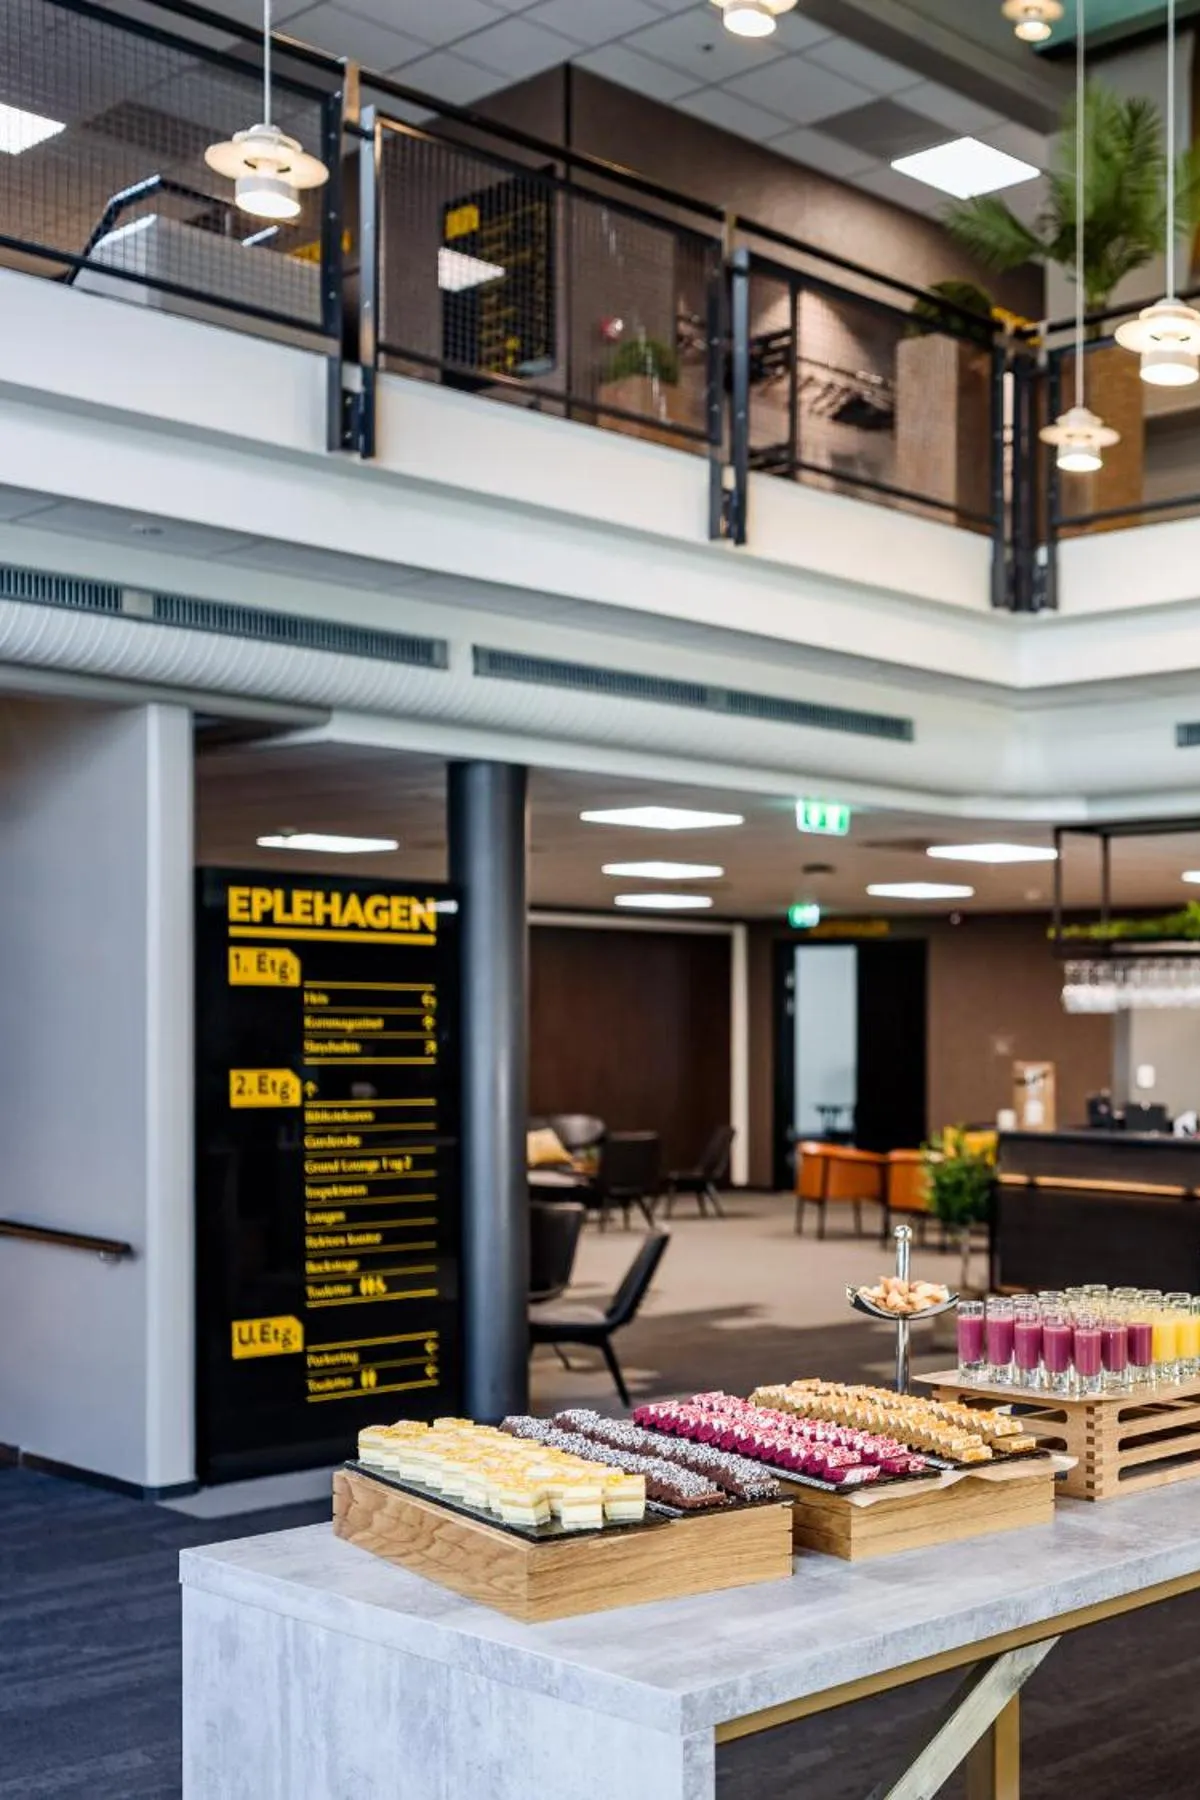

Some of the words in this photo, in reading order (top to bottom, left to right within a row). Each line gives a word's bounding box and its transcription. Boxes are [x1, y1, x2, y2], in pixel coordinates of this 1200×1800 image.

[228, 885, 437, 932] EPLEHAGEN
[234, 951, 249, 974] 1.
[236, 1074, 254, 1096] 2.
